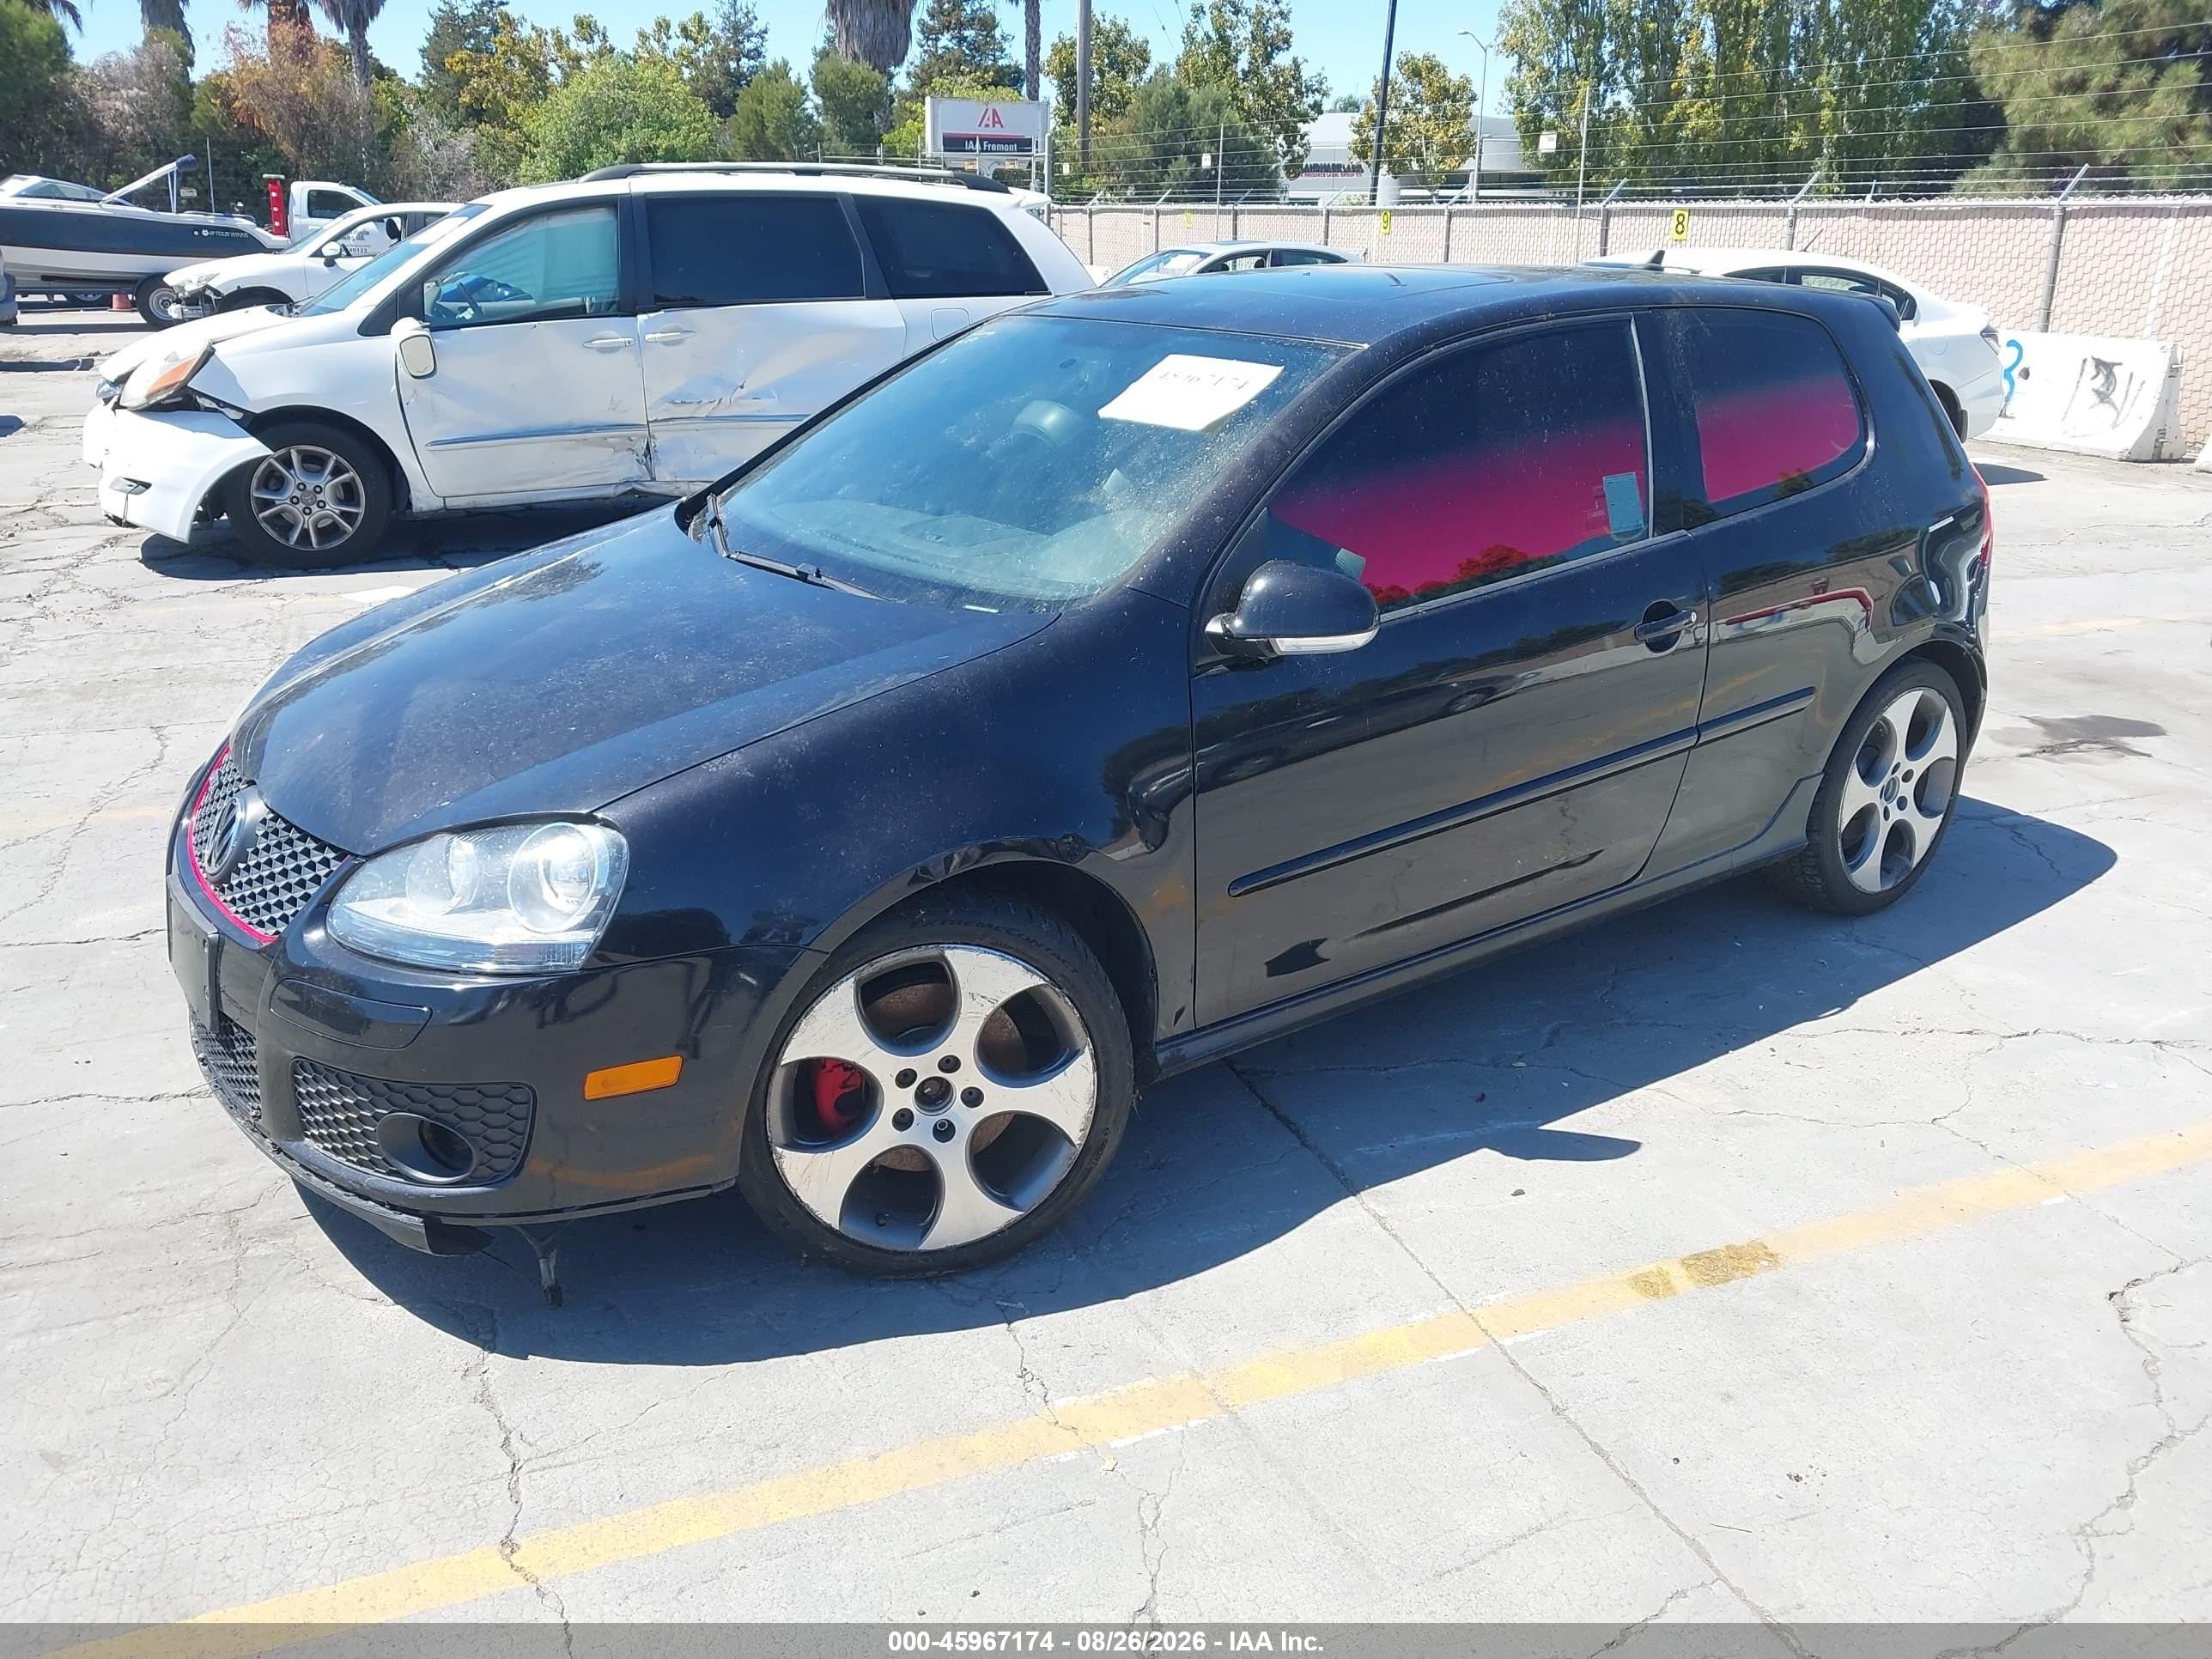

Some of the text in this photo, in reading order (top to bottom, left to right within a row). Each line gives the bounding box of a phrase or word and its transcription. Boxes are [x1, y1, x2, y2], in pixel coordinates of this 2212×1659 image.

[964, 139, 1018, 152] IAA Fremont
[1382, 211, 1389, 229] 9
[1675, 213, 1685, 234] 8
[1790, 219, 1794, 228] 8
